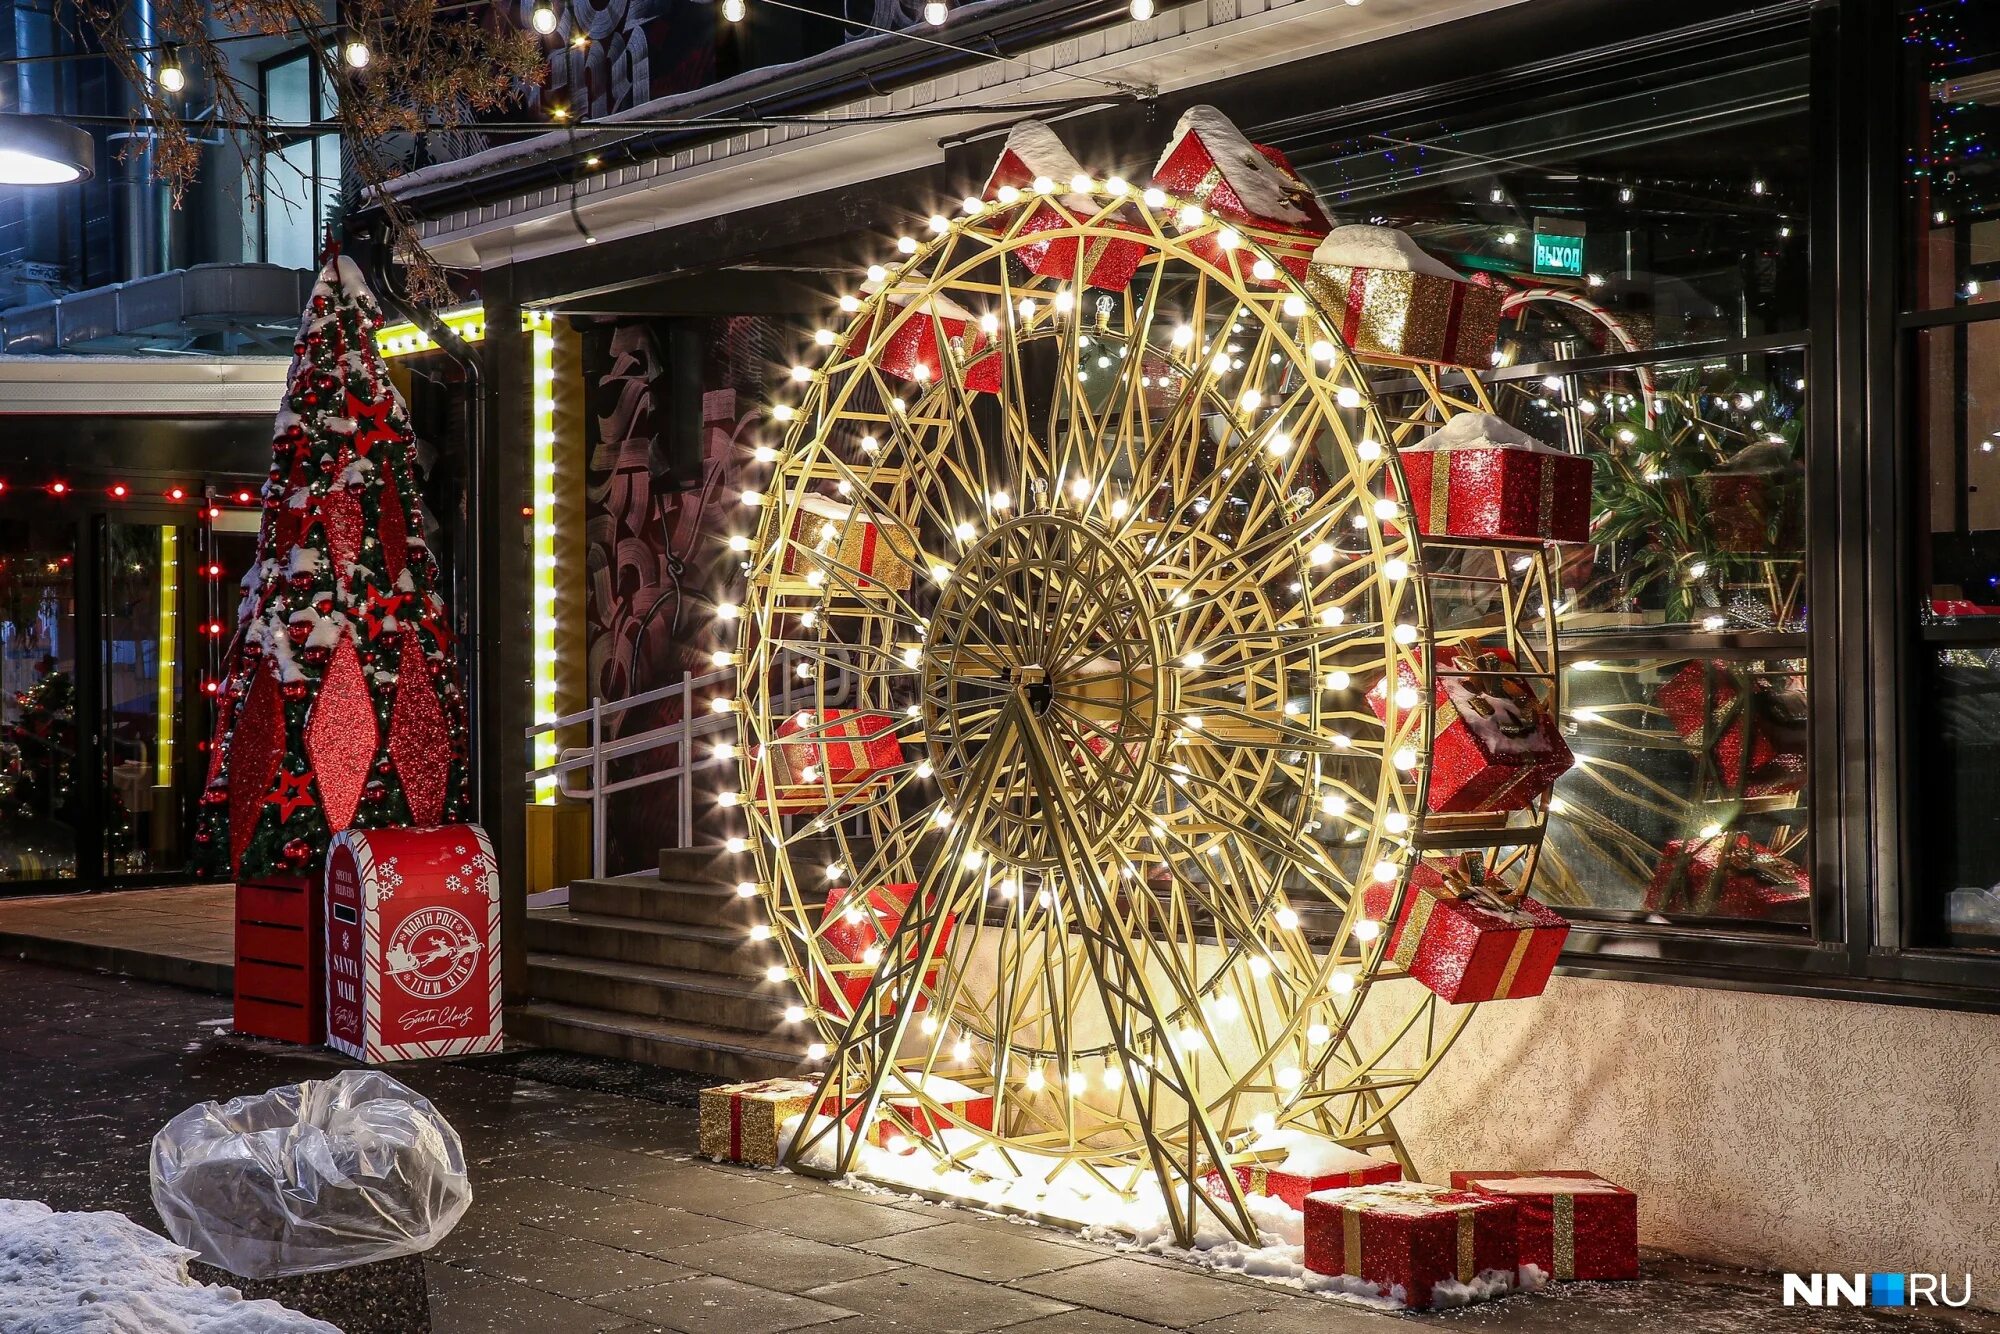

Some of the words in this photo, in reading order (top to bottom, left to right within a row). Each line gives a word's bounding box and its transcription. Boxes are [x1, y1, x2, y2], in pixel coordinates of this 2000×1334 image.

[1537, 245, 1580, 272] ВЫХОД
[402, 912, 433, 937] NORTH
[436, 912, 459, 929] POLE
[333, 953, 358, 979] SANTA
[446, 965, 468, 987] AIR
[337, 979, 357, 1003] MAIL
[410, 977, 441, 995] MAIL
[398, 1009, 439, 1031] Santa
[438, 1006, 473, 1027] Claus
